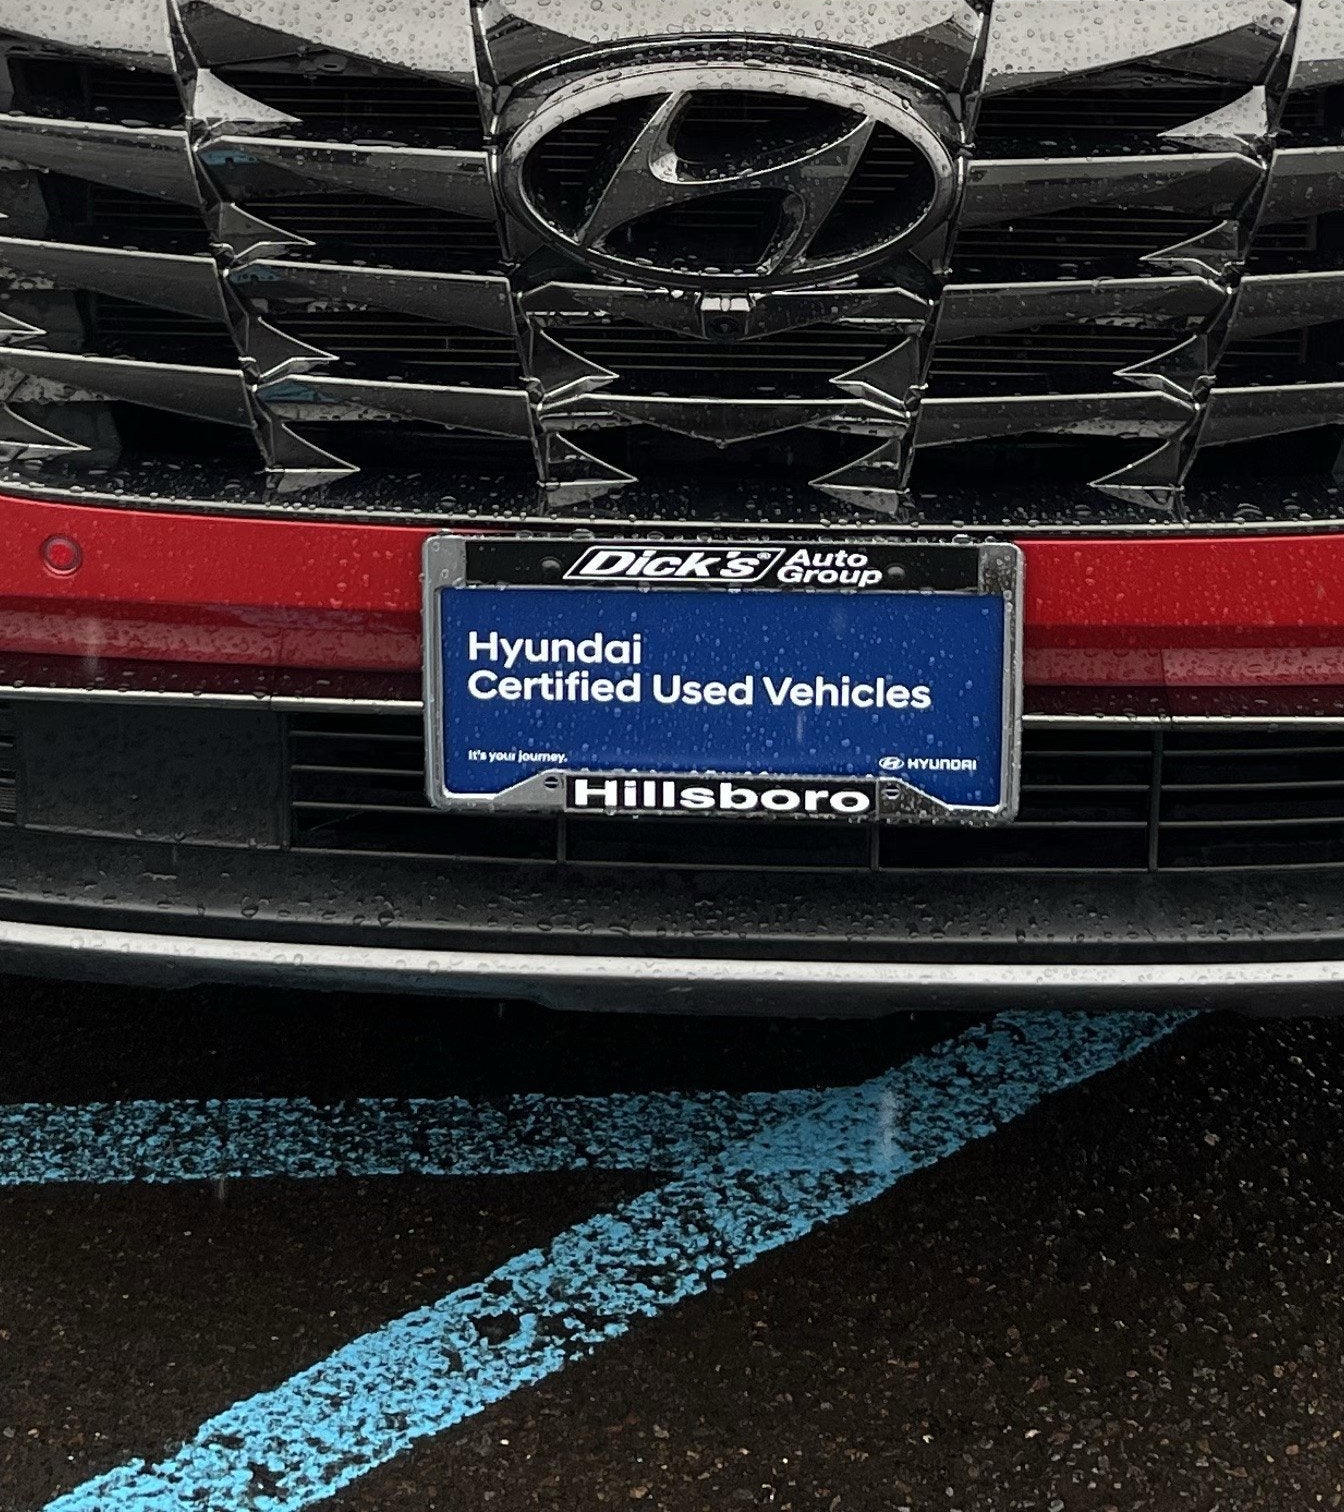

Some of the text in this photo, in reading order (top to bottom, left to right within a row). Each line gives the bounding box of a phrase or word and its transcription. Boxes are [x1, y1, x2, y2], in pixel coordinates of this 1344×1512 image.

[578, 550, 760, 578] Dick's
[785, 548, 869, 568] Auto
[777, 565, 883, 587] Group
[468, 631, 642, 668] Hyundai
[467, 670, 932, 709] Certified Used Vehicles
[907, 758, 977, 771] HYUNDAI
[574, 779, 871, 812] Hillsboro
